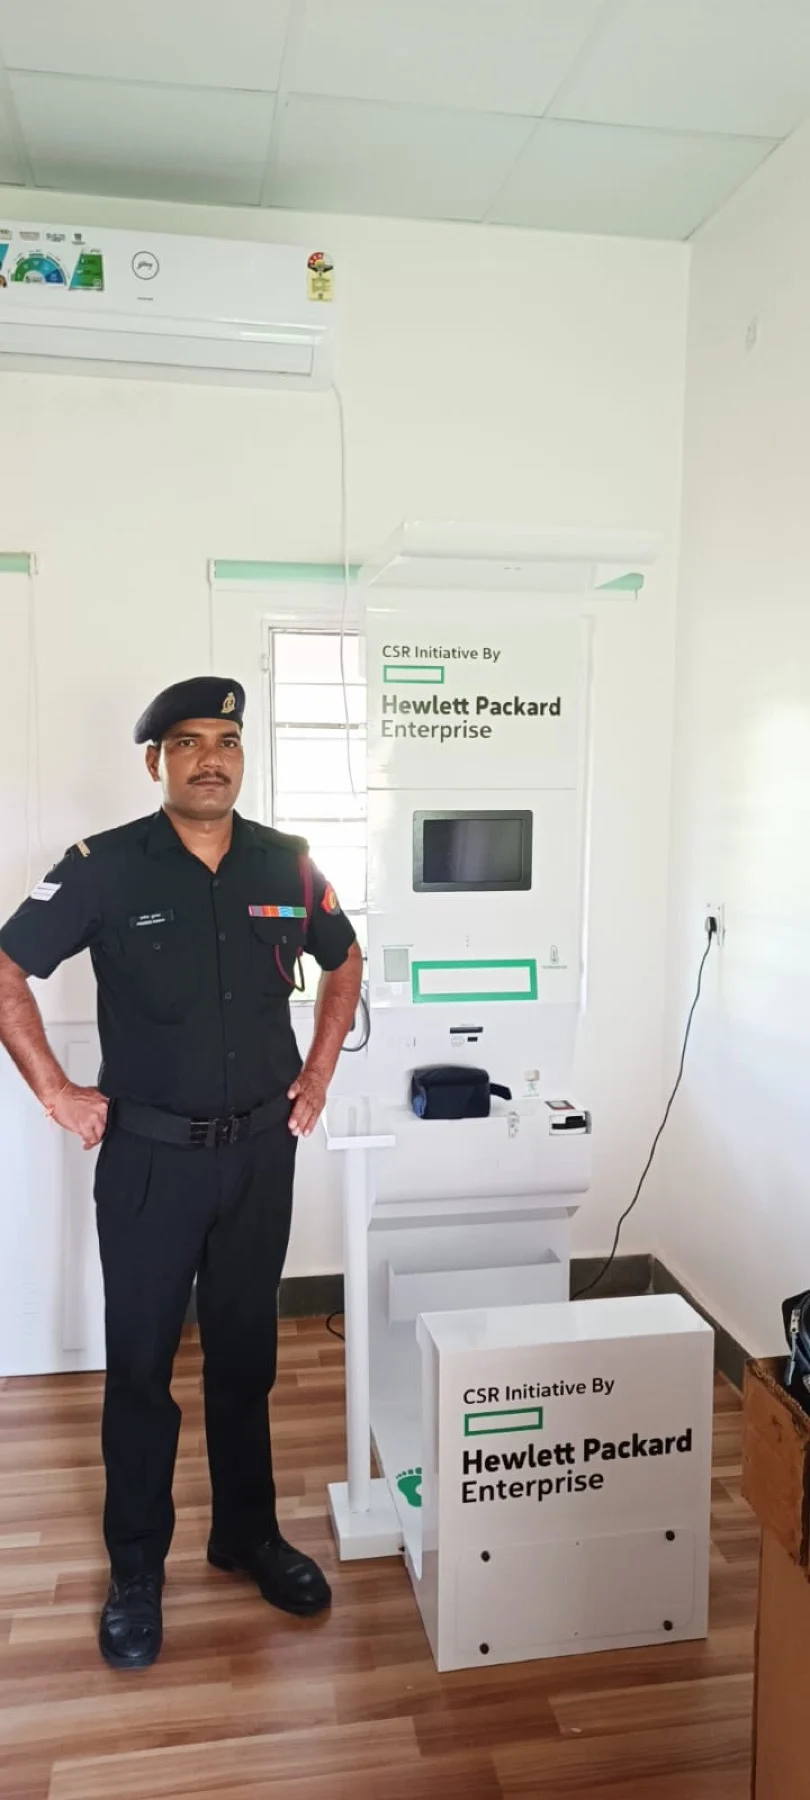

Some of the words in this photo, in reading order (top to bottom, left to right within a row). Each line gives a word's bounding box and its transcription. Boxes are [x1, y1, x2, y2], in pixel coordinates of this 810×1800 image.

[382, 645, 411, 658] CSR
[415, 645, 479, 660] Initiative
[483, 647, 501, 663] By
[382, 694, 470, 715] Hewlett
[476, 696, 562, 717] Packard
[381, 719, 493, 743] Enterprise
[463, 1387, 500, 1405] CSR
[505, 1380, 587, 1402] Initiative
[592, 1377, 615, 1395] By
[462, 1442, 575, 1475] Hewlett
[583, 1428, 693, 1463] Packard
[461, 1469, 604, 1504] Enterprise
